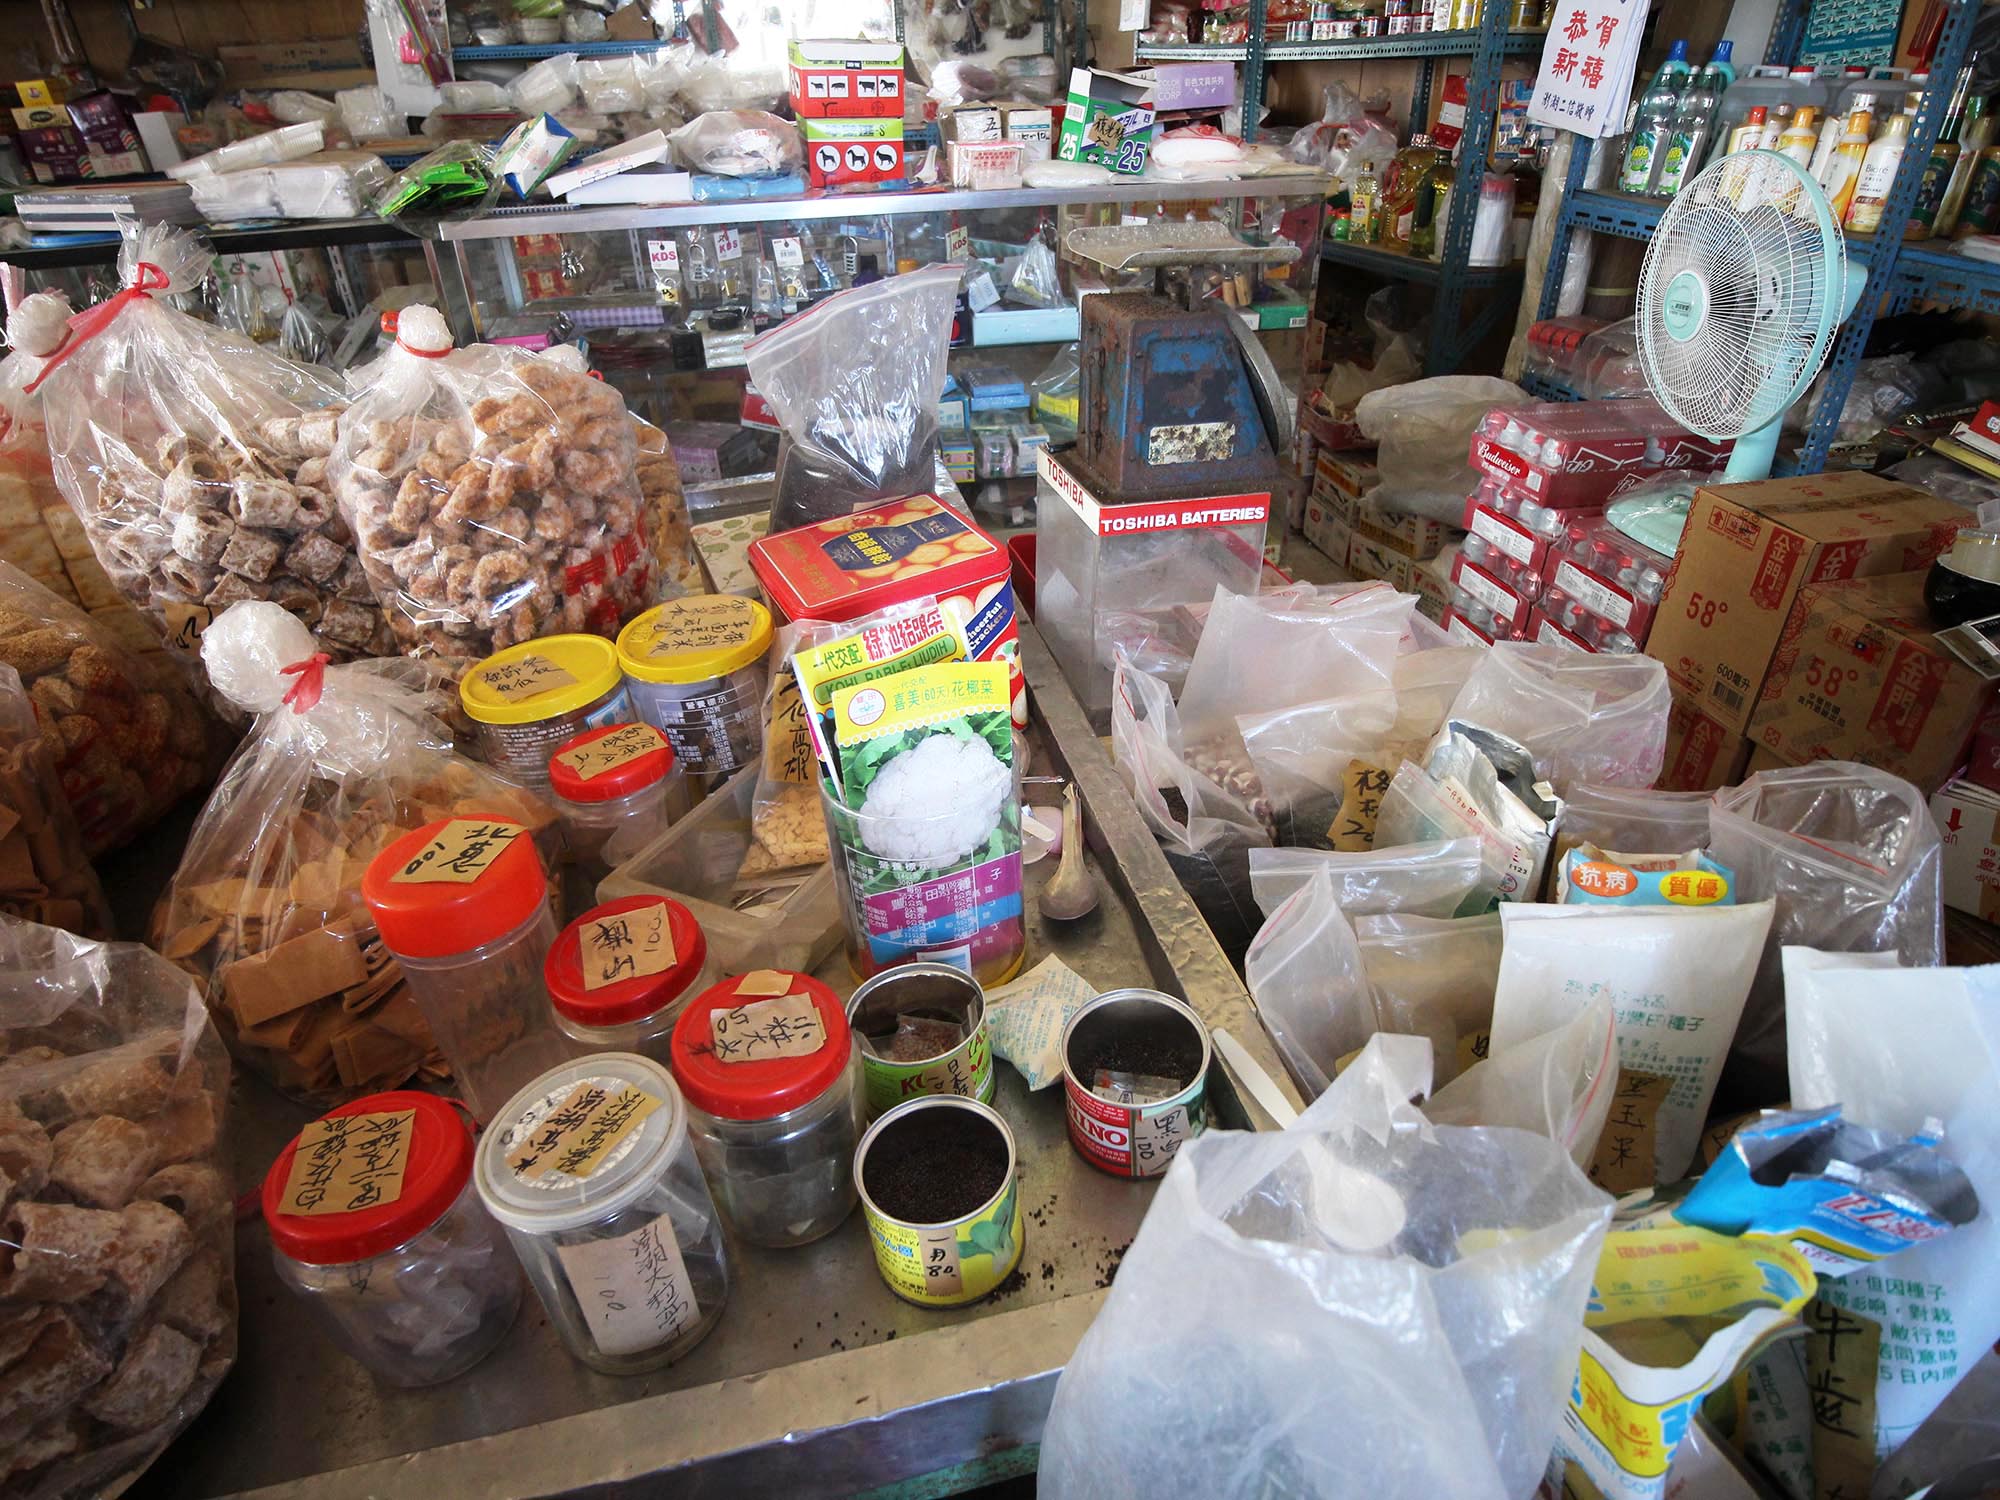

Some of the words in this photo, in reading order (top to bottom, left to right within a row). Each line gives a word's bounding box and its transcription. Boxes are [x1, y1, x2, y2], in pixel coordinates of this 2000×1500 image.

[1563, 10, 1619, 51] 恭賀
[1552, 47, 1605, 90] 新禧
[1060, 132, 1078, 160] 25
[1116, 140, 1147, 173] 25
[651, 250, 677, 262] KDS
[951, 236, 967, 251] KDS
[1477, 441, 1521, 476] Budweiser
[1047, 458, 1084, 510] TOSHIBA
[1102, 513, 1177, 532] TOSHIBA
[1181, 506, 1265, 525] BATTERIES
[1759, 533, 1791, 592] 金門
[1820, 546, 1848, 581] 金
[1686, 591, 1729, 629] 58°
[813, 642, 863, 672] 一代交配
[912, 640, 948, 668] LIUDIH
[1806, 655, 1859, 697] 58°
[1881, 651, 1928, 727] 金門
[1943, 834, 1959, 847] UP
[1580, 867, 1628, 891] 抗病
[1669, 876, 1719, 899] 質優
